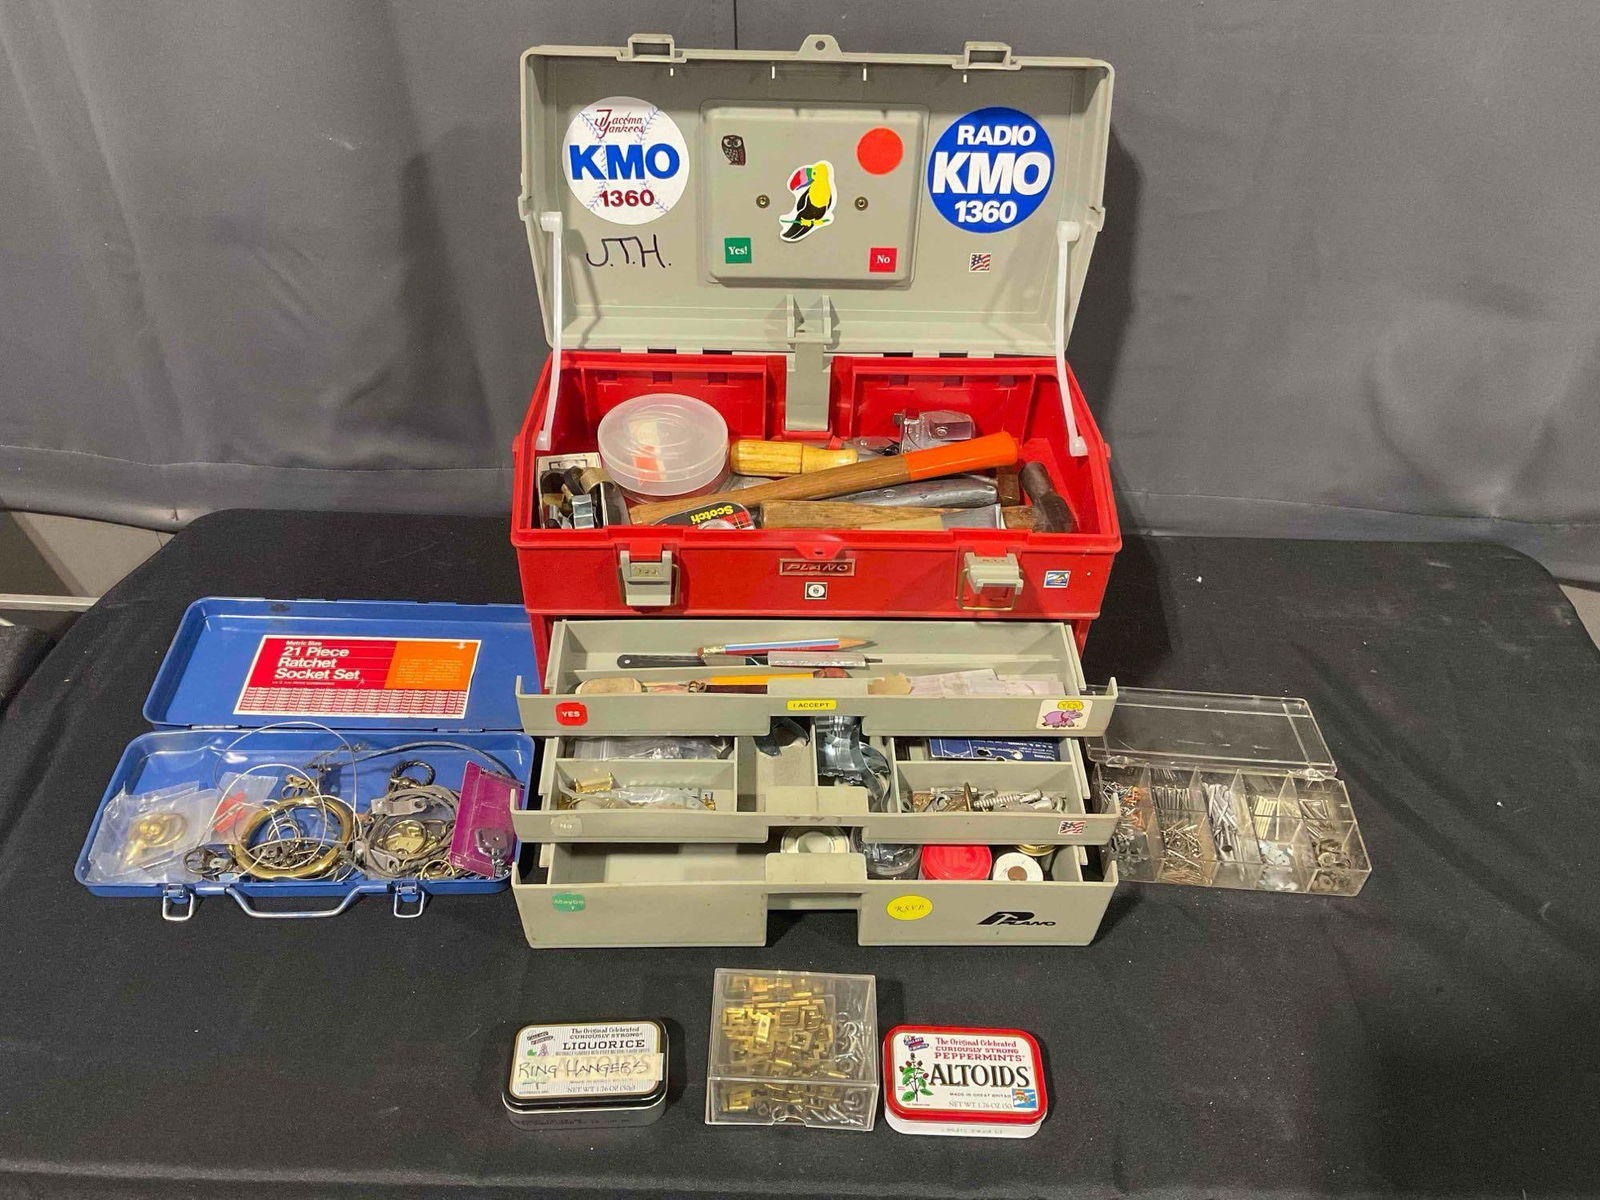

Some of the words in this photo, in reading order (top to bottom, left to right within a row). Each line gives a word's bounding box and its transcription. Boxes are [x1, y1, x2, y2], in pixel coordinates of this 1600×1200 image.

[595, 109, 643, 127] Tacoma
[597, 121, 645, 139] Yankees
[957, 125, 1036, 146] RADIO
[569, 143, 680, 180] KMO
[932, 151, 1051, 196] KMO
[599, 190, 655, 207] 1360
[954, 200, 1018, 223] 1360
[728, 245, 748, 255] Yes!
[876, 255, 891, 264] No
[690, 505, 734, 525] Scotch
[786, 562, 849, 572] PLANO
[282, 646, 301, 656] 21
[306, 646, 350, 657] Piece
[278, 657, 338, 668] Ratchet
[274, 668, 330, 679] Socket
[333, 669, 361, 680] Set
[562, 710, 581, 718] YES
[562, 1039, 646, 1050] LIQUORICE
[935, 1037, 949, 1045] The
[950, 1038, 979, 1047] Original
[980, 1040, 1017, 1048] Celebrated
[519, 1062, 558, 1078] RING
[566, 1060, 649, 1077] HANGERS
[928, 1063, 1030, 1088] ALTOIDS
